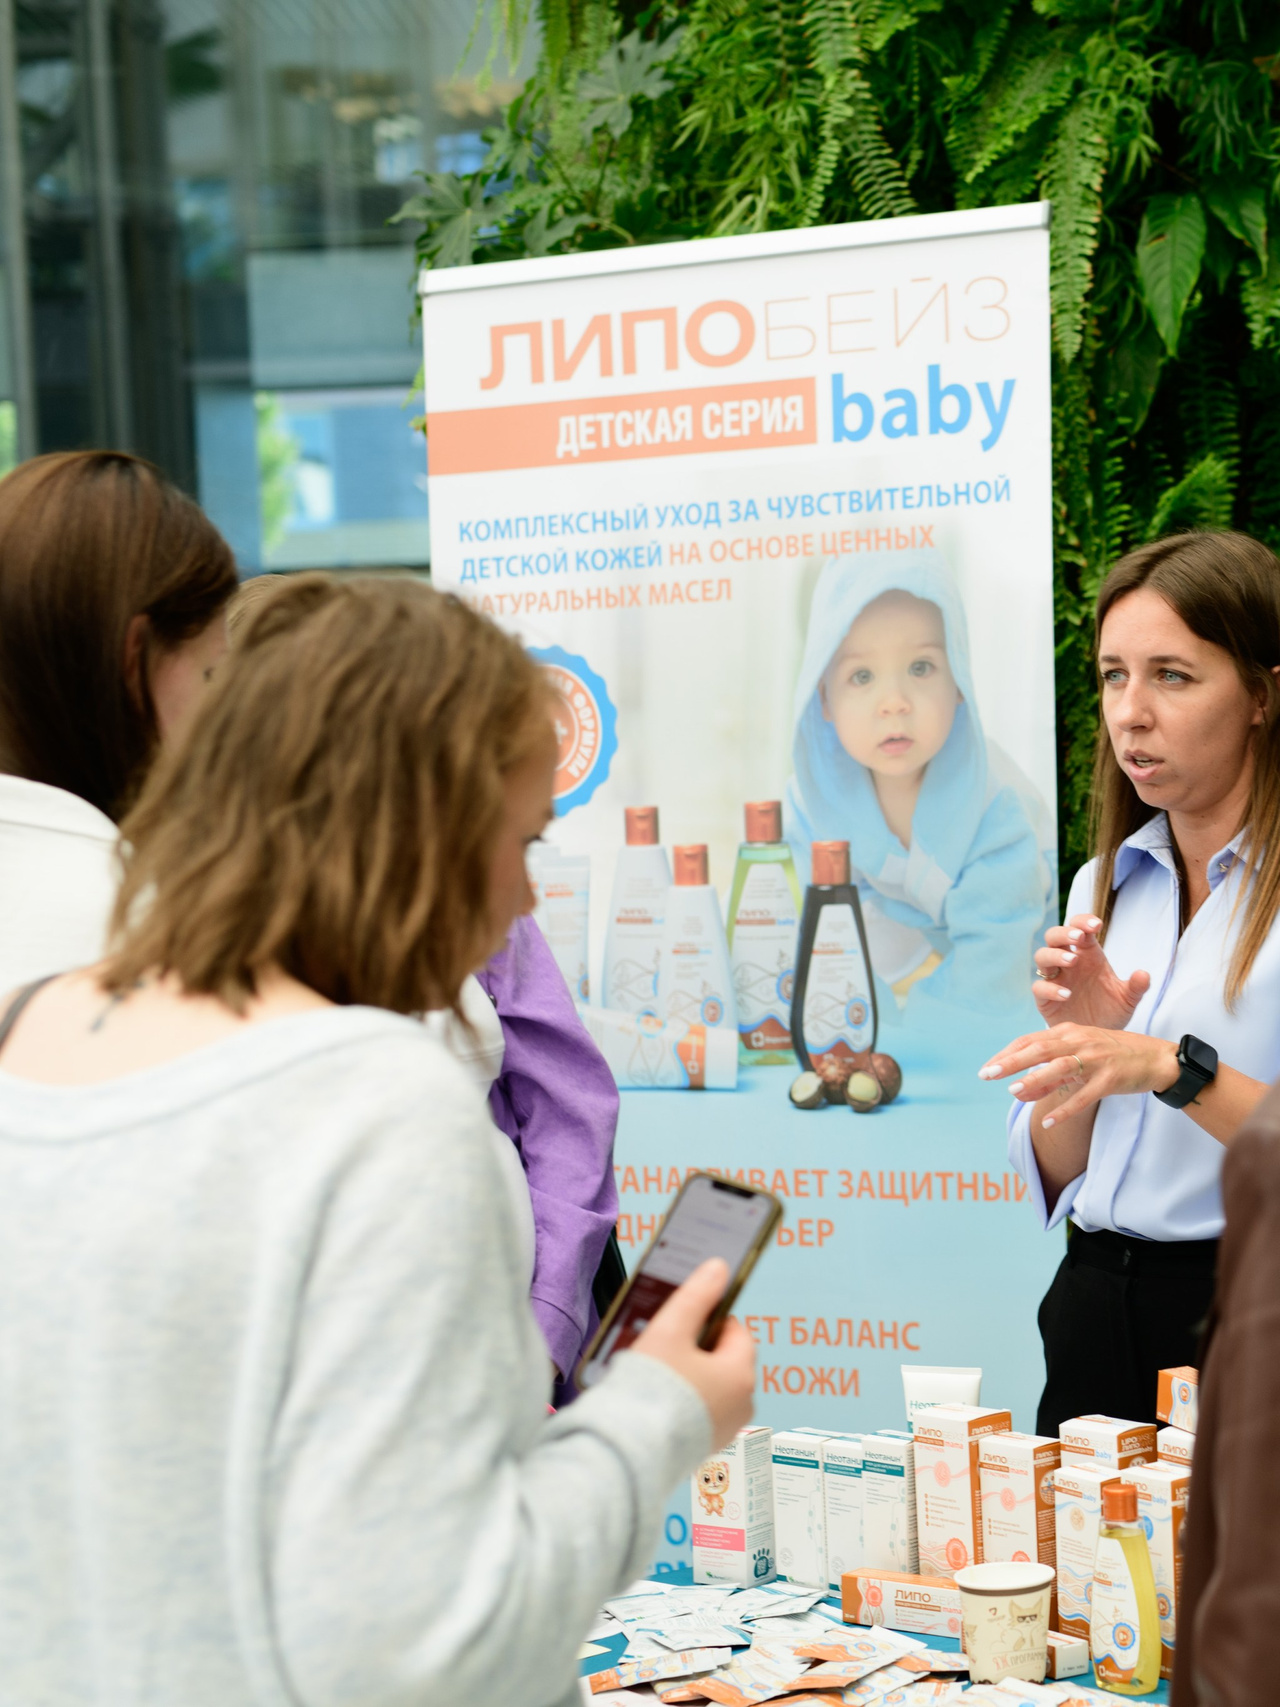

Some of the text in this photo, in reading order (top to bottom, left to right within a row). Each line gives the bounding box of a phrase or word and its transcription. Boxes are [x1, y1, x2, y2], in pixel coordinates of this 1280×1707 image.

[556, 394, 805, 458] ДЕТСКАЯ СЕРИЯ
[831, 364, 1017, 452] baby
[458, 475, 1012, 544] КОМПЛЕКСНЫЙ УХОД ЗА ЧУВСТВИТЕЛЬНОЙ
[459, 524, 936, 584] ДЕТСКОЙ КОЖЕЙ НА ОСНОВЕ ЦЕННЫХ
[648, 578, 733, 606] МАСЕЛ
[567, 692, 596, 779] ФОРМУЛА
[789, 1317, 921, 1352] БАЛАНС
[762, 1364, 860, 1398] КОЖИ
[1095, 1449, 1112, 1461] baby
